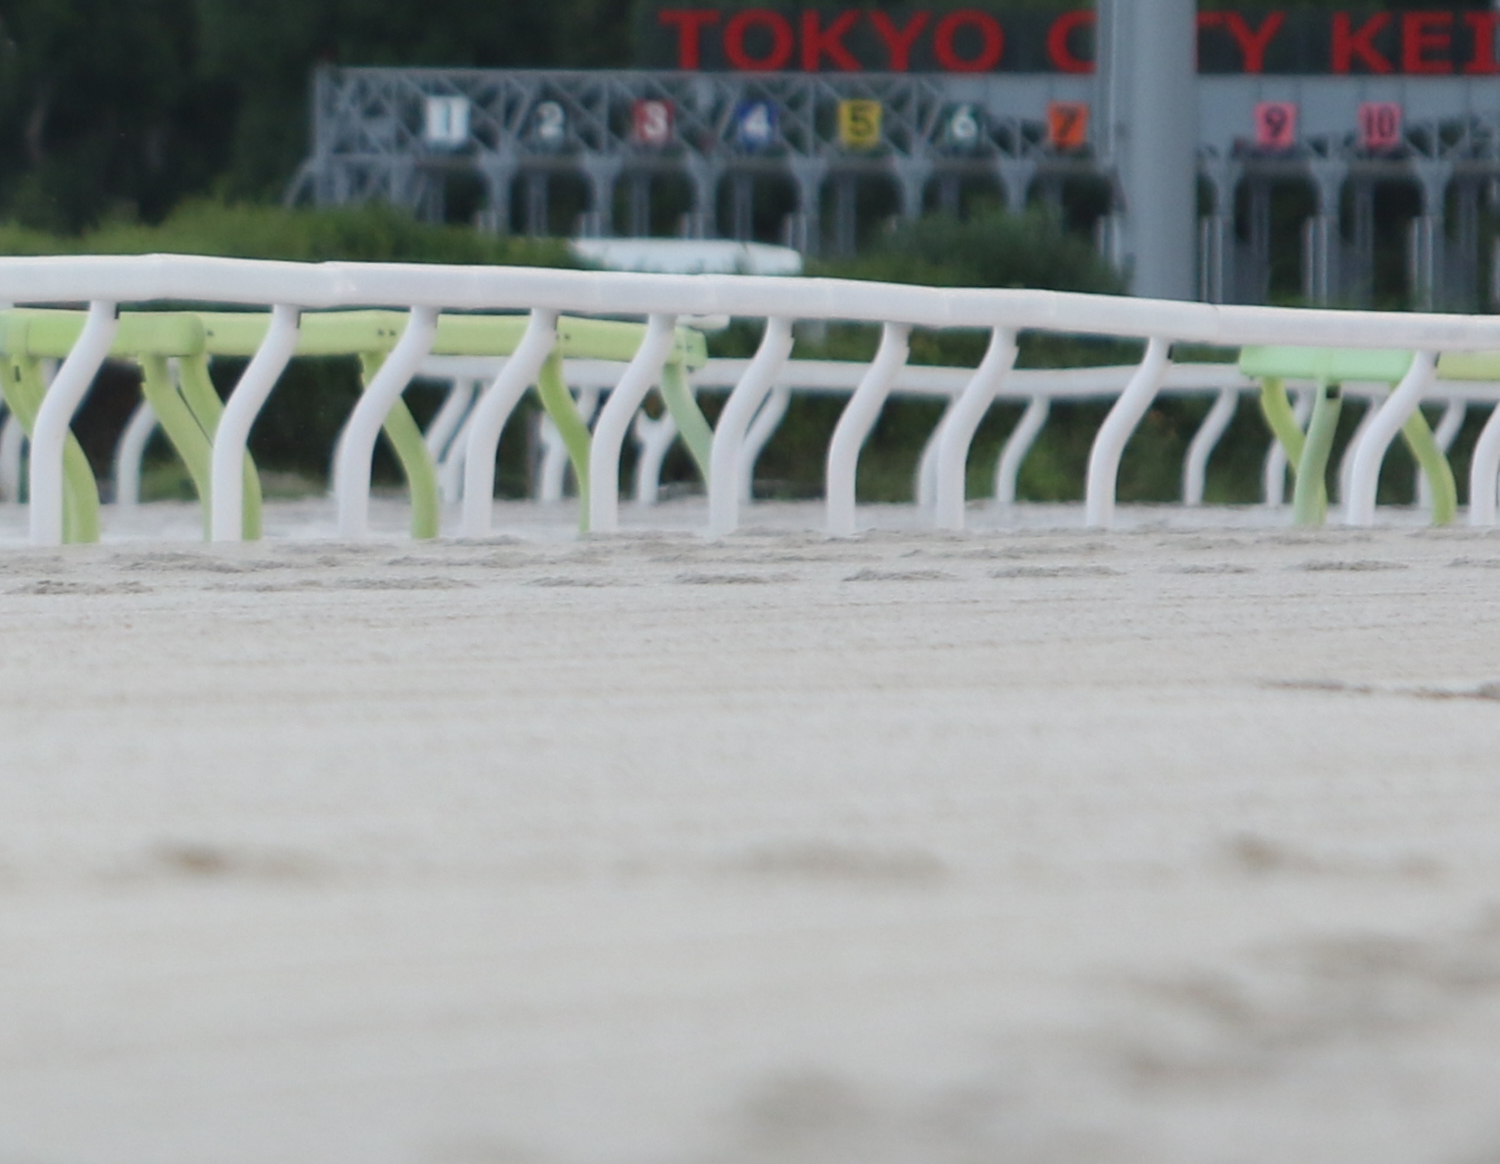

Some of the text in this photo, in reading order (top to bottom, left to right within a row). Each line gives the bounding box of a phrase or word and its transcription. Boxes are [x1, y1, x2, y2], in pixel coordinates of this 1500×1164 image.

[658, 9, 1500, 74] TOKYO CY KEI
[537, 101, 564, 138] 2
[643, 101, 669, 137] 3
[743, 106, 770, 138] 4
[849, 104, 873, 140] 5
[953, 106, 976, 140] 6
[1054, 107, 1079, 139] 7
[1264, 106, 1286, 138] 9
[1364, 105, 1394, 140] 10
